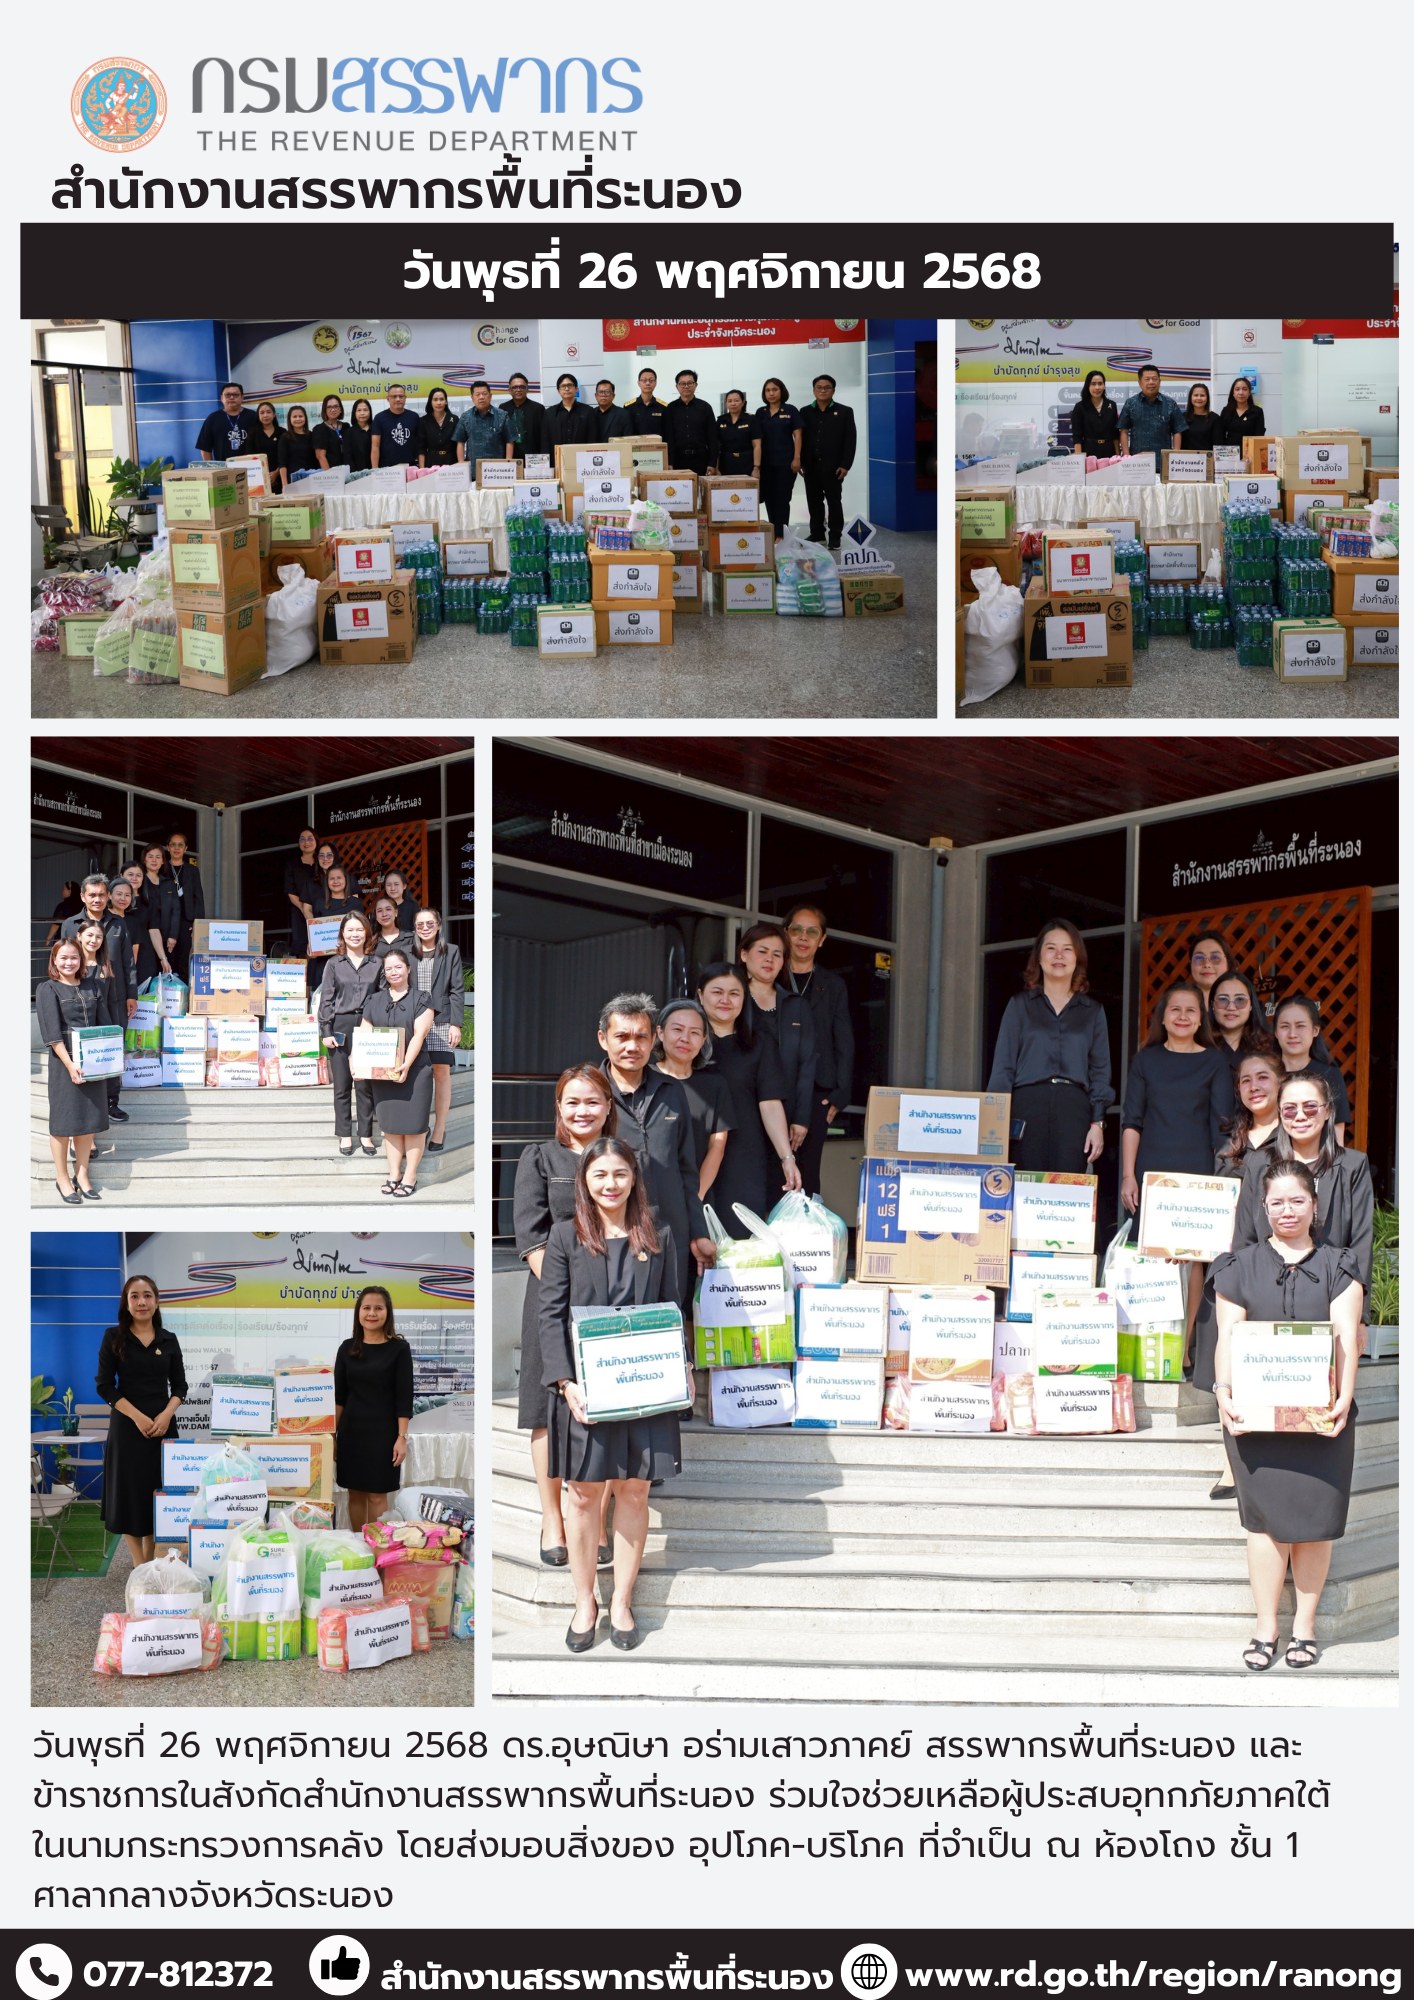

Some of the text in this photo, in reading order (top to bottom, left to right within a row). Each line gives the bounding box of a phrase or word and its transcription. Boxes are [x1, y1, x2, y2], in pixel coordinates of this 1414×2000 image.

[1178, 319, 1201, 327] Good
[496, 335, 529, 343] for Good
[687, 327, 776, 339] ประจำจังหวัดระนอง
[993, 365, 1081, 378] บำบัดทุกข์ บำรุงสุข
[581, 468, 616, 476] ส่งกำลังใจ
[1304, 462, 1343, 472] ส่งกำลังใจ
[588, 494, 624, 503] ส่งกำลังใจ
[844, 549, 880, 565] คปภ.
[612, 582, 652, 592] ส่งกำลังใจ
[614, 626, 654, 636] ส่งกำลังใจ
[546, 634, 587, 645] ส่งกำลังใจ
[1290, 655, 1336, 668] ส่งกำลังใจ
[551, 809, 693, 868] สำนักงานสรรพากรพื้นที่สาขาเมืองระนอง
[1172, 831, 1362, 887] สำนักงานสรรพากรพื้นที่ระนอง
[200, 966, 210, 974] 12
[908, 1110, 977, 1121] สำนักงานสรรพากร
[922, 1123, 962, 1135] พื้นที่ระนอง
[878, 1184, 898, 1199] 12
[1022, 1197, 1091, 1209] สำนักงานสรรพากร
[877, 1203, 896, 1217] ฟรี
[1036, 1209, 1075, 1222] พื้นที่ระนอง
[881, 1223, 889, 1239] 1
[709, 1282, 781, 1293] สำนักงานสรรพากร
[280, 1286, 337, 1302] บำบัดทุกข์
[725, 1296, 767, 1308] พื้นที่ระนอง
[809, 1303, 880, 1314] สำนักงานสรรพากร
[824, 1317, 865, 1329] พื้นที่ระนอง
[921, 1314, 992, 1324] สำนักงานสรรพากร
[936, 1328, 976, 1339] พื้นที่ระนอง
[999, 1342, 1032, 1358] ปลาก
[596, 1351, 681, 1368] สำนักงานสรรพากร
[1243, 1353, 1329, 1364] สำนักงานสรรพากร
[615, 1369, 664, 1385] พื้นที่ระนอง
[806, 1375, 876, 1386] สำนักงานสรรพากร
[1261, 1369, 1312, 1382] พื้นที่ระนอง
[282, 1384, 333, 1394] สำนักงานสรรพากร
[721, 1382, 791, 1395] สำนักงานสรรพากร
[1045, 1388, 1110, 1398] สำนักงานสรรพากร
[294, 1396, 324, 1404] พื้นที่ระนอง
[820, 1389, 861, 1401] พื้นที่ระนอง
[219, 1396, 271, 1407] สำนักงานสรรพากร
[737, 1396, 777, 1409] พื้นที่ระนอง
[1059, 1401, 1097, 1413] พื้นที่ระนอง
[230, 1408, 260, 1417] พื้นที่ระนอง
[235, 1570, 295, 1584] สำนักงานสรรพากร
[248, 1584, 284, 1595] พื้นที่ระนอง
[328, 1579, 381, 1592] สำนักงานสรรพากร
[388, 1582, 423, 1593] MAMA
[340, 1592, 372, 1603] พื้นที่ระนอง
[354, 1618, 410, 1637] สำนักงานสรรพากร
[131, 1632, 199, 1643] สำนักงานสรรพากร
[368, 1633, 399, 1649] พื้นที่ระนอง
[145, 1644, 186, 1657] พื้นที่ระนอง
